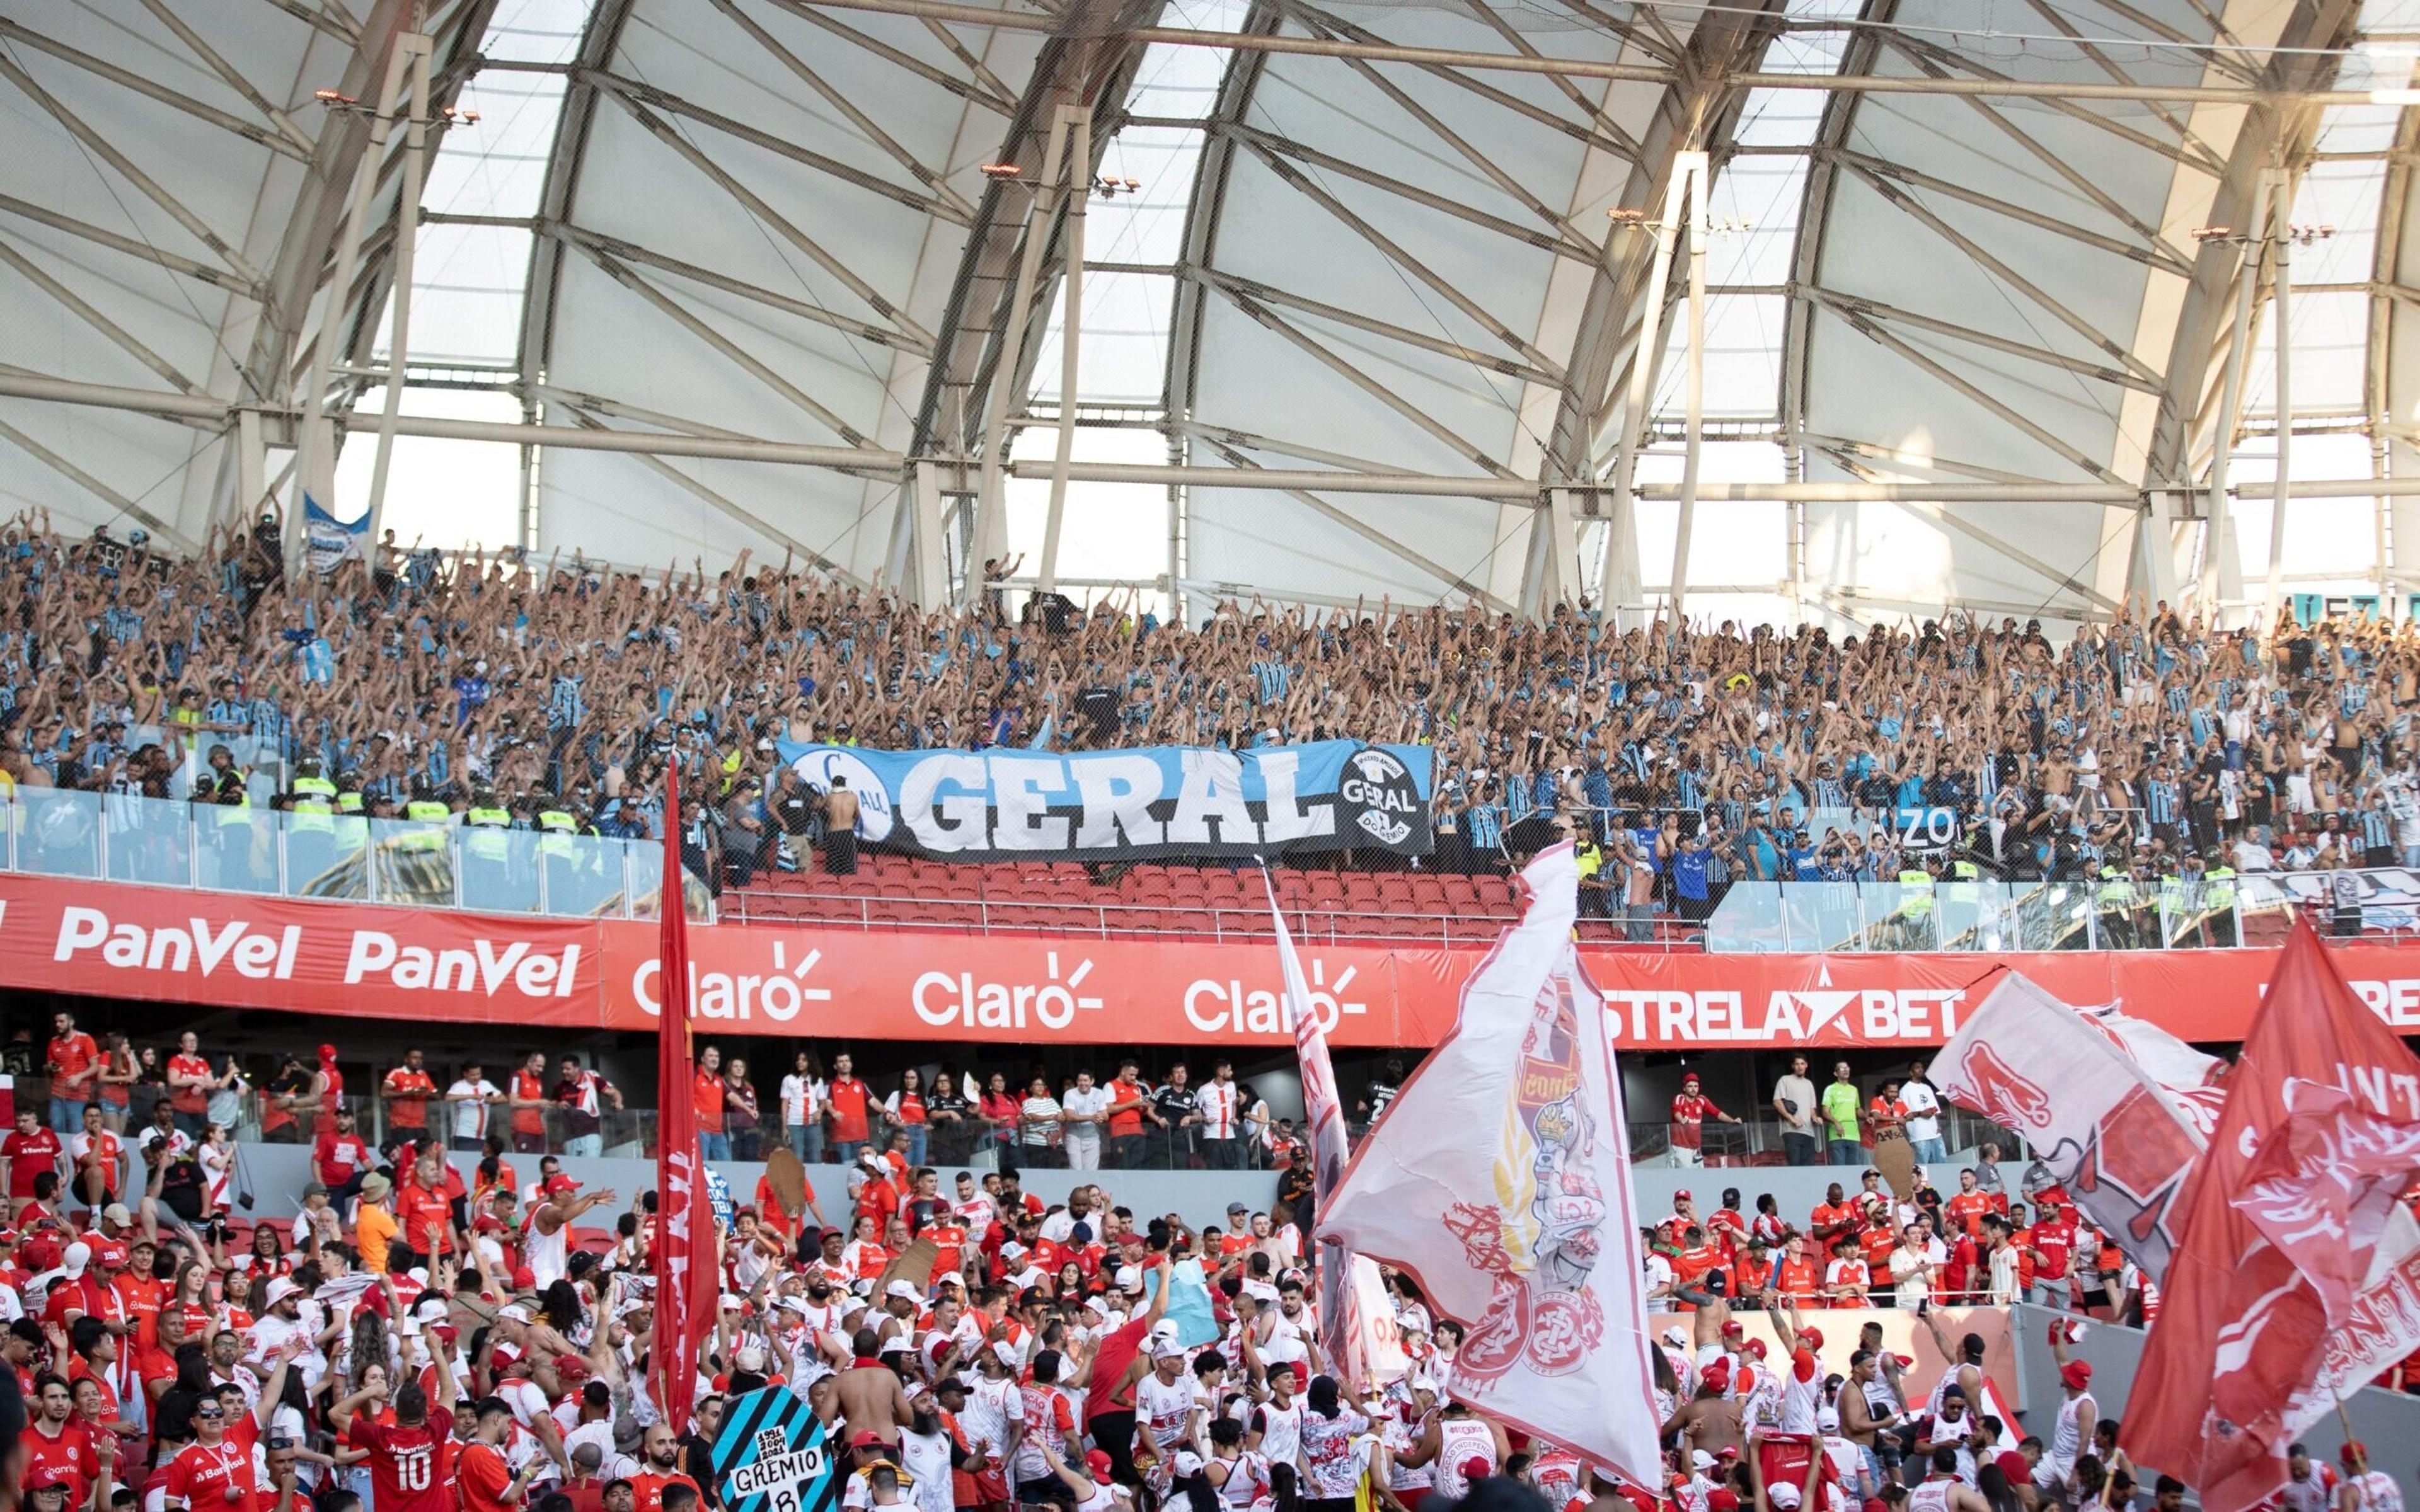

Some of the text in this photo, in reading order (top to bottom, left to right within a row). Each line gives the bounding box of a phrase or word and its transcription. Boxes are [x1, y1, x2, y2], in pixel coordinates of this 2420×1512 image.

[899, 753, 1335, 852] GERAL
[1343, 779, 1417, 813] GERAL
[54, 906, 301, 980] PanVel
[345, 930, 580, 998] PanVel
[633, 956, 800, 1022] Claro
[911, 969, 1075, 1030] Claro
[1861, 989, 1966, 1039] BET
[758, 1431, 782, 1441] 1991
[759, 1437, 786, 1448] 2004
[762, 1446, 785, 1460] 2021
[205, 1455, 246, 1479] Banisul
[394, 1452, 432, 1491] 10
